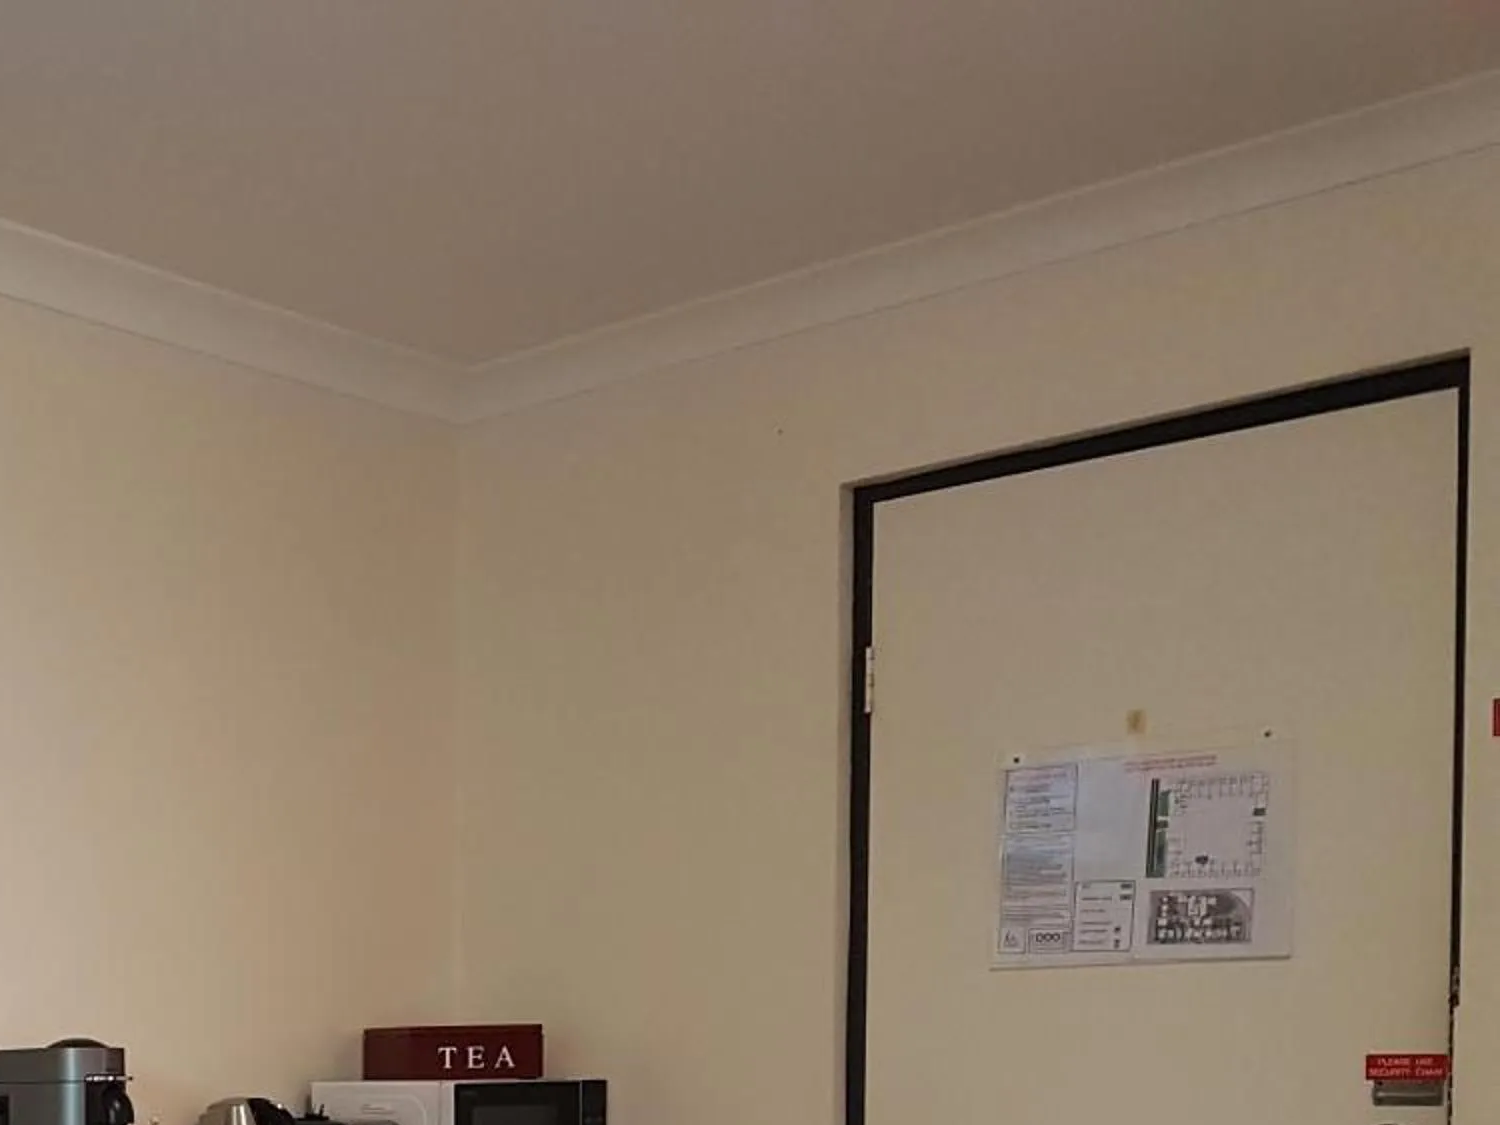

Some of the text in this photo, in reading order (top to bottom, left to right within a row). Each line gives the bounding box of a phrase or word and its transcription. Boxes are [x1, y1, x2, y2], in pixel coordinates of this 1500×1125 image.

[437, 1045, 516, 1069] TEA
[1377, 1057, 1410, 1067] PLEASE
[1368, 1067, 1412, 1078] SECURITY
